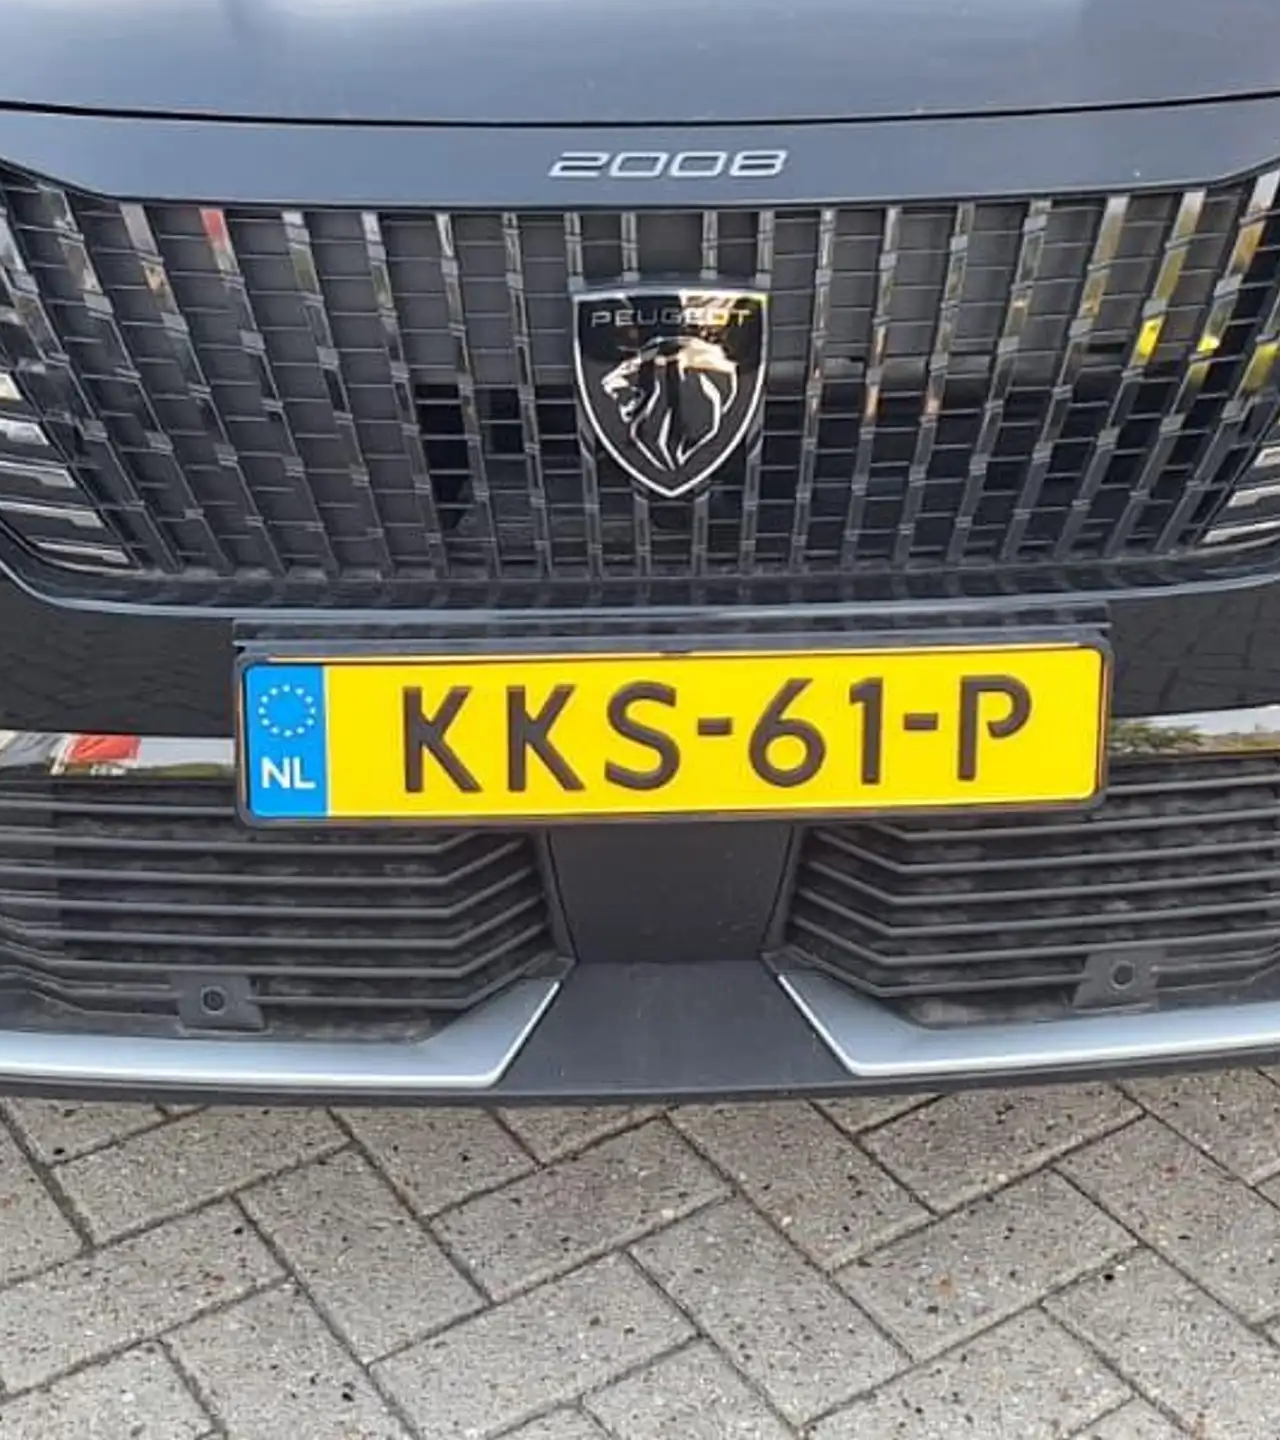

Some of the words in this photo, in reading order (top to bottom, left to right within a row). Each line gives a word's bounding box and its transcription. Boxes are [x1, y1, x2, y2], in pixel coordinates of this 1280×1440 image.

[548, 150, 788, 178] 2008
[590, 310, 753, 327] PEUGEOT
[261, 756, 317, 790] NL
[401, 675, 1032, 795] KKS-61-P
